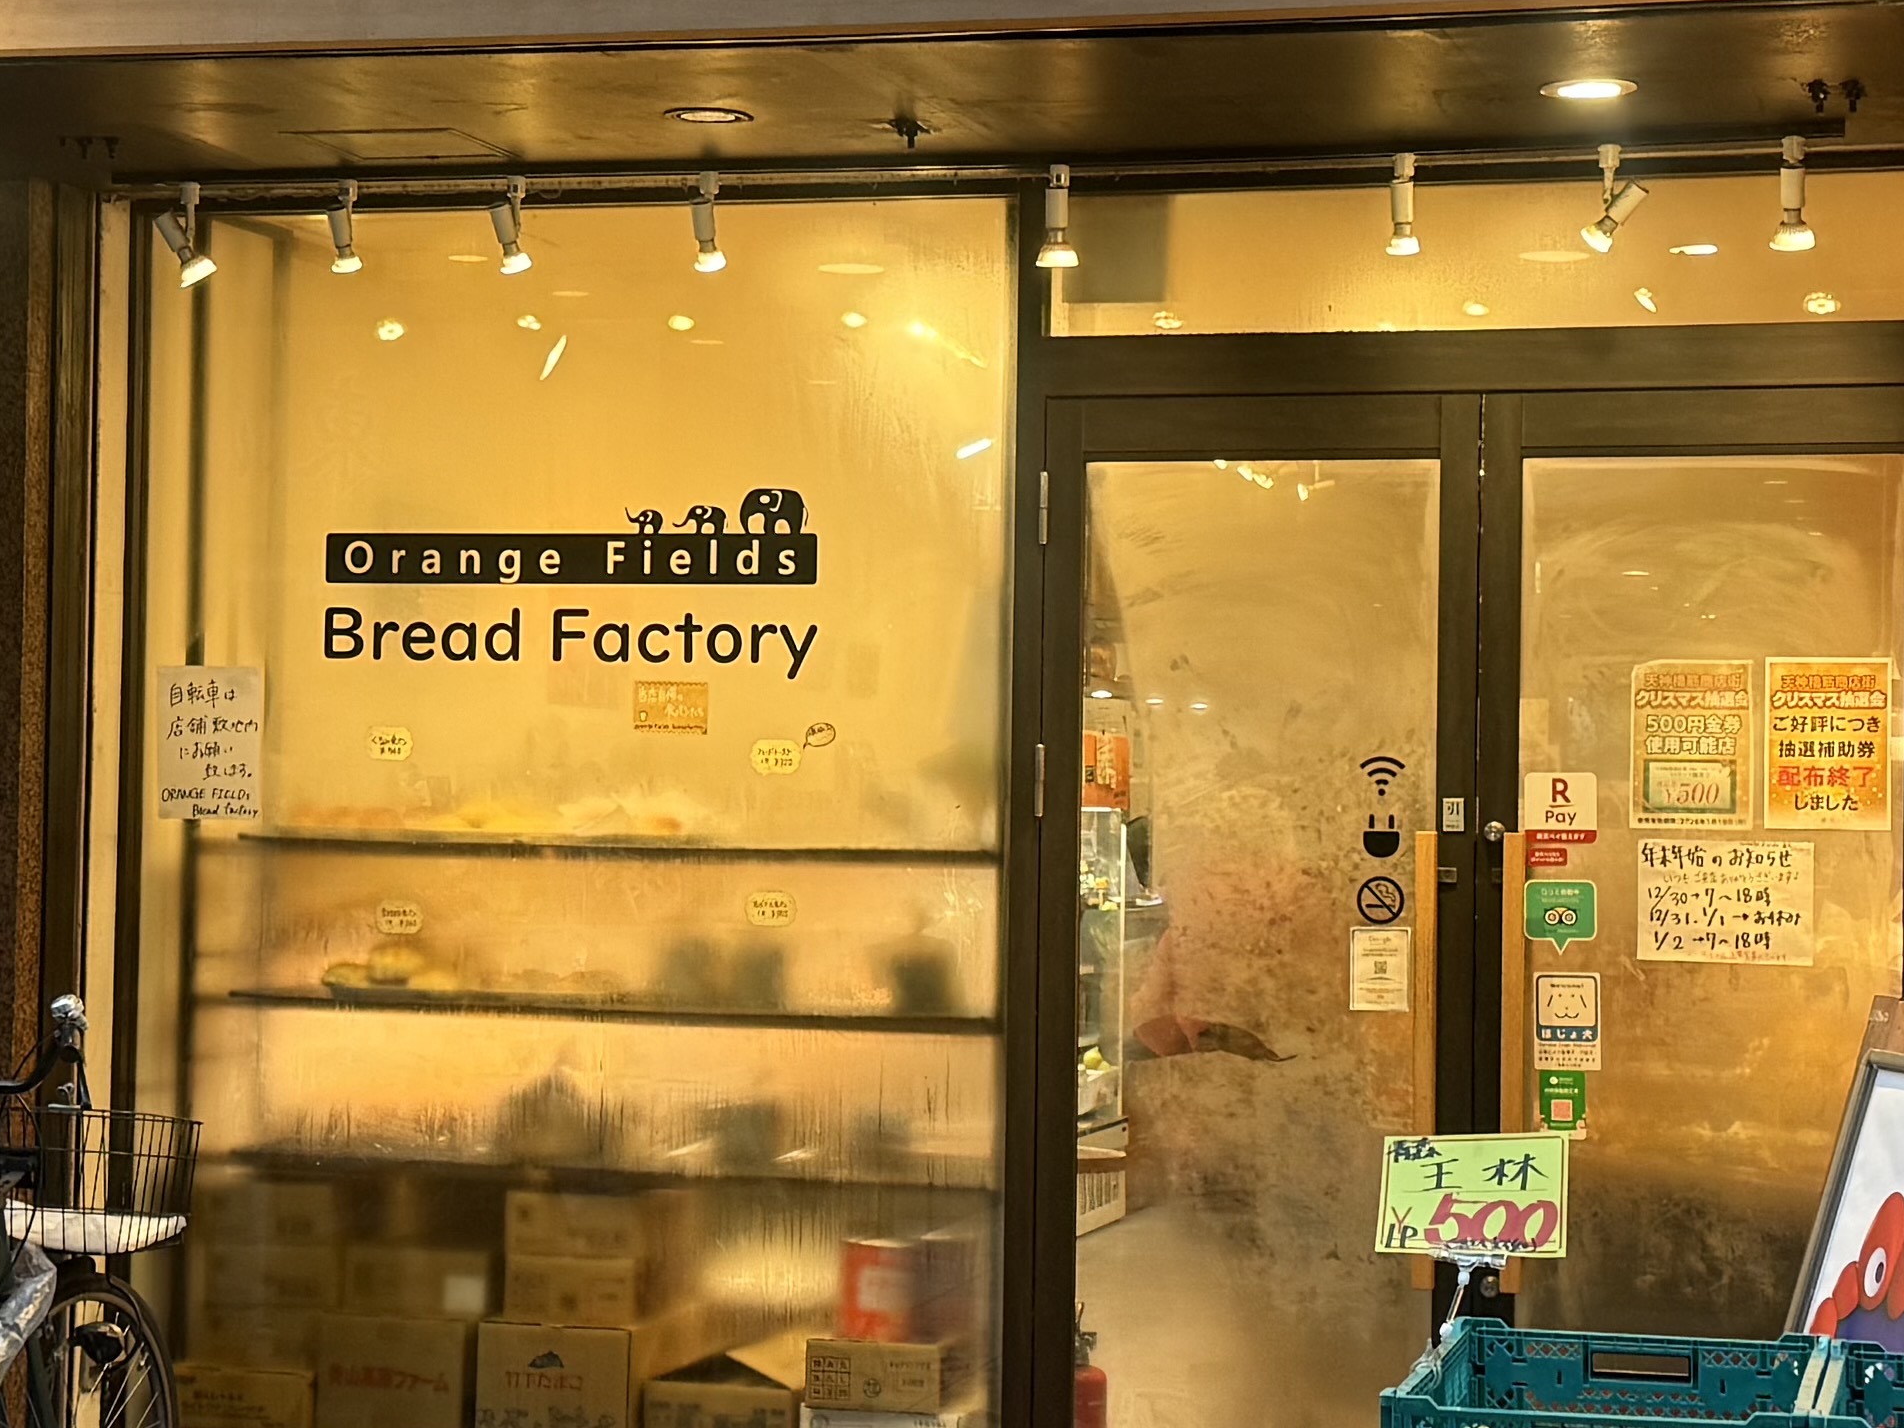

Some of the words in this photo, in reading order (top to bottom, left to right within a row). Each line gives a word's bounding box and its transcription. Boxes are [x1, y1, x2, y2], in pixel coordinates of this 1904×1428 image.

[343, 540, 561, 584] Orange
[606, 538, 796, 575] Fields
[323, 606, 521, 662] Bread
[552, 609, 818, 680] Factory
[170, 679, 237, 709] 自転車は
[1772, 690, 1887, 710] クリスマス抽選会
[1646, 714, 1743, 735] 500円金券
[1772, 715, 1882, 734] ご好評につき
[1646, 736, 1737, 756] 使用可能店
[1779, 739, 1876, 759] 抽選補助券
[1777, 765, 1875, 788] 配布終了
[1551, 777, 1572, 804] R
[1794, 793, 1859, 812] しました
[1544, 809, 1578, 826] Pay
[1641, 843, 1793, 870] 年末年始のお知らせ
[1541, 1028, 1594, 1040] ほじょ犬
[1420, 1153, 1549, 1191] 王林
